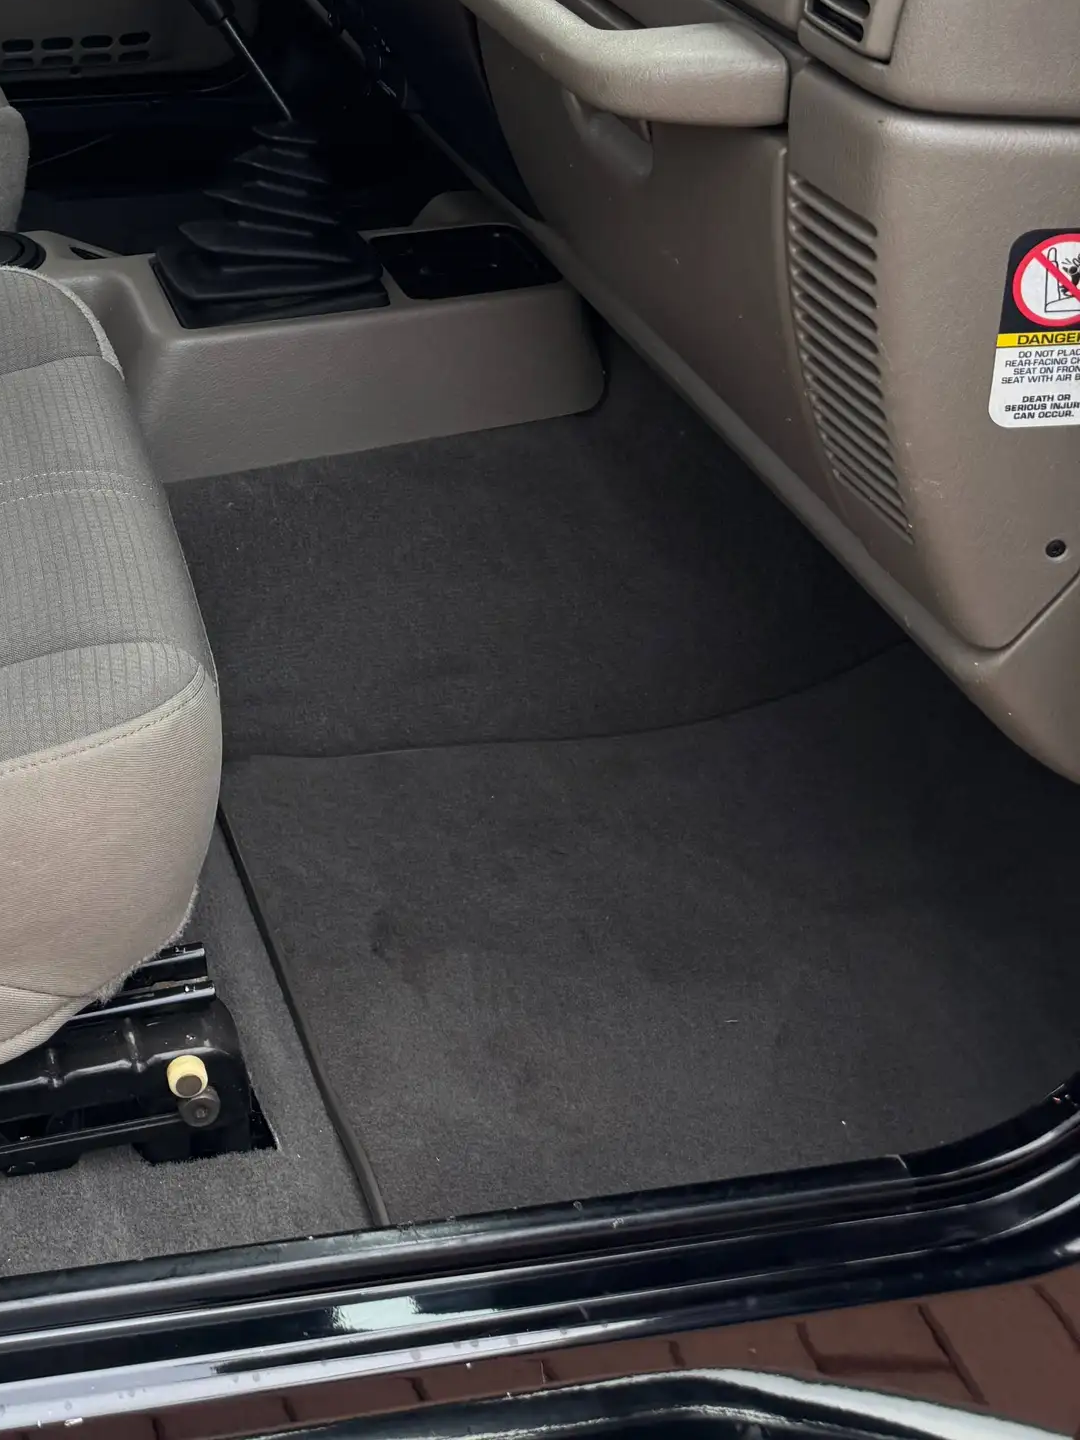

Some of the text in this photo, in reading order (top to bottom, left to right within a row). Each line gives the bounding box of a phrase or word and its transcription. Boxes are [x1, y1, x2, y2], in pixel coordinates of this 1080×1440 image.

[1034, 350, 1055, 358] NOT
[1005, 358, 1068, 367] REAR-FACING
[1039, 366, 1054, 374] ON
[1001, 376, 1024, 384] SEAT
[1056, 373, 1072, 381] AIR
[1022, 393, 1071, 403] DEATH OR
[1004, 403, 1047, 412] SERIOUS
[1013, 410, 1074, 420] CAN OCCUR.
